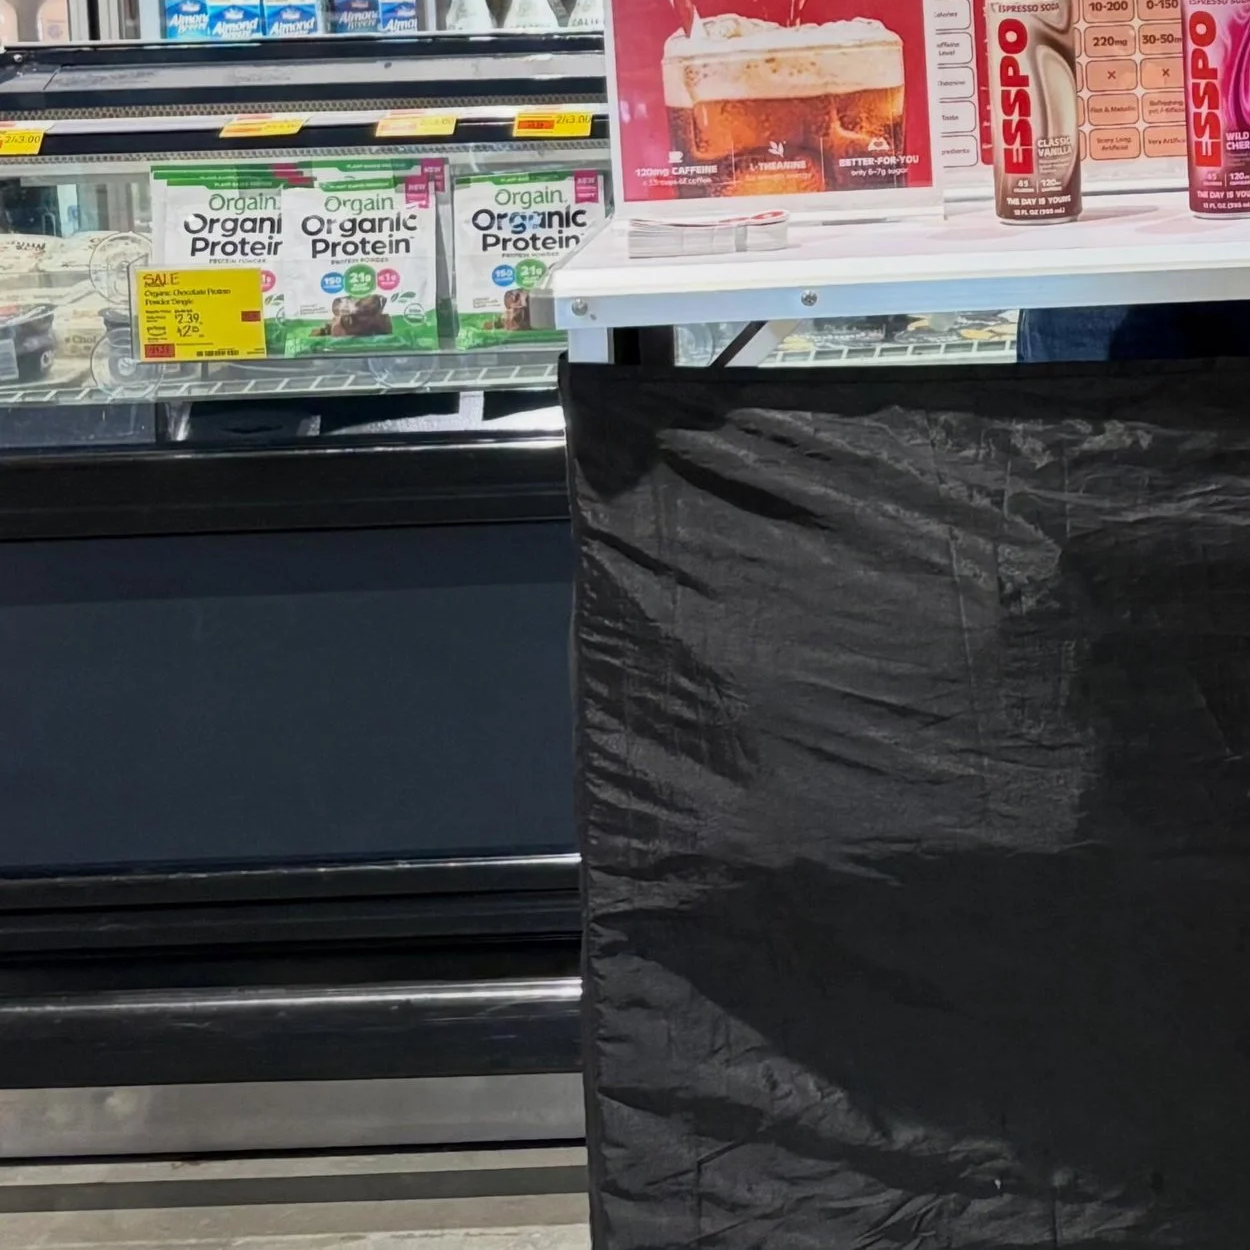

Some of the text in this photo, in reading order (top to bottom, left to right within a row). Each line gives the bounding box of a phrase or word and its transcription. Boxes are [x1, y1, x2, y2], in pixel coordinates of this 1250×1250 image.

[998, 3, 1060, 13] ESPRESSO SODA
[1088, 0, 1128, 11] 10-200
[1146, 0, 1179, 10] 0-150
[212, 18, 259, 36] Almond
[270, 18, 315, 37] Almond
[1093, 36, 1127, 47] 220mg
[1142, 34, 1182, 44] 30-50m
[998, 18, 1034, 174] ESSPO
[1189, 10, 1222, 168] ESSPO
[1037, 136, 1071, 147] CLASSIC
[1226, 131, 1249, 140] WILD
[1038, 146, 1072, 157] VANILLA
[839, 155, 919, 167] BETTER-FOR-YOU
[635, 164, 718, 177] 120mg CAFFEINE
[209, 194, 281, 215] Orgain
[324, 194, 395, 215] Orgain
[494, 188, 568, 209] Orgain
[184, 213, 282, 238] Organi
[301, 213, 418, 238] Organic
[472, 205, 587, 235] Organic
[311, 236, 411, 259] Protein
[482, 233, 580, 252] Protein
[143, 272, 179, 286] SALE
